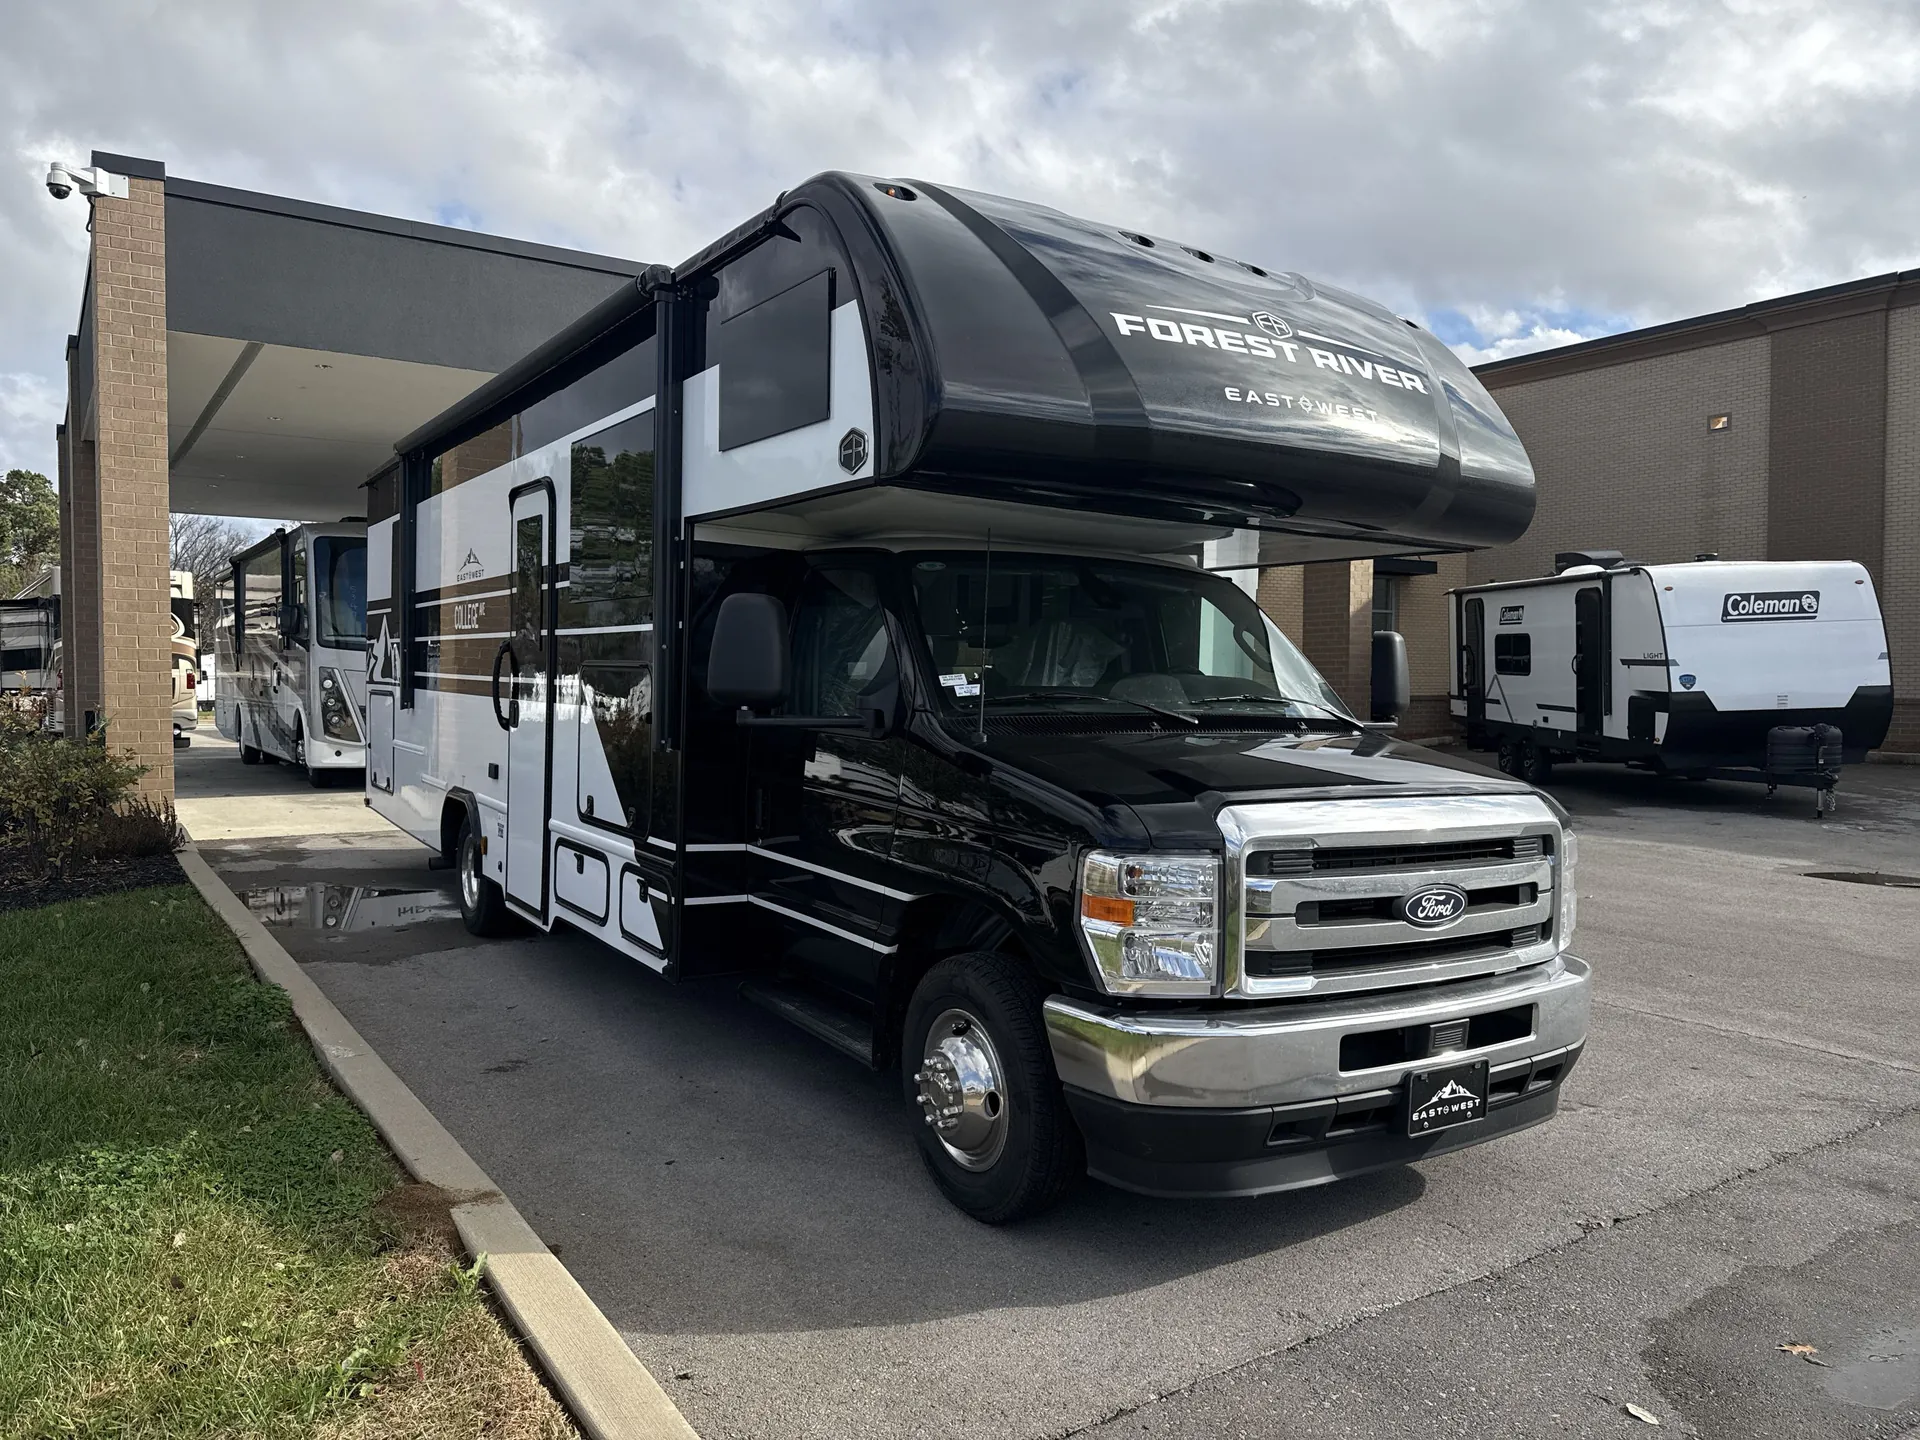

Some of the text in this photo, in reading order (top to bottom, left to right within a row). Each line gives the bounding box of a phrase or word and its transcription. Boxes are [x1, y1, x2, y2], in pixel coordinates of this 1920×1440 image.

[1109, 312, 1428, 395] FOREST RIVER
[1224, 387, 1378, 422] EAST WEST
[454, 602, 479, 629] COLLEGE
[1727, 594, 1800, 616] Coleman
[1417, 894, 1455, 918] Ford
